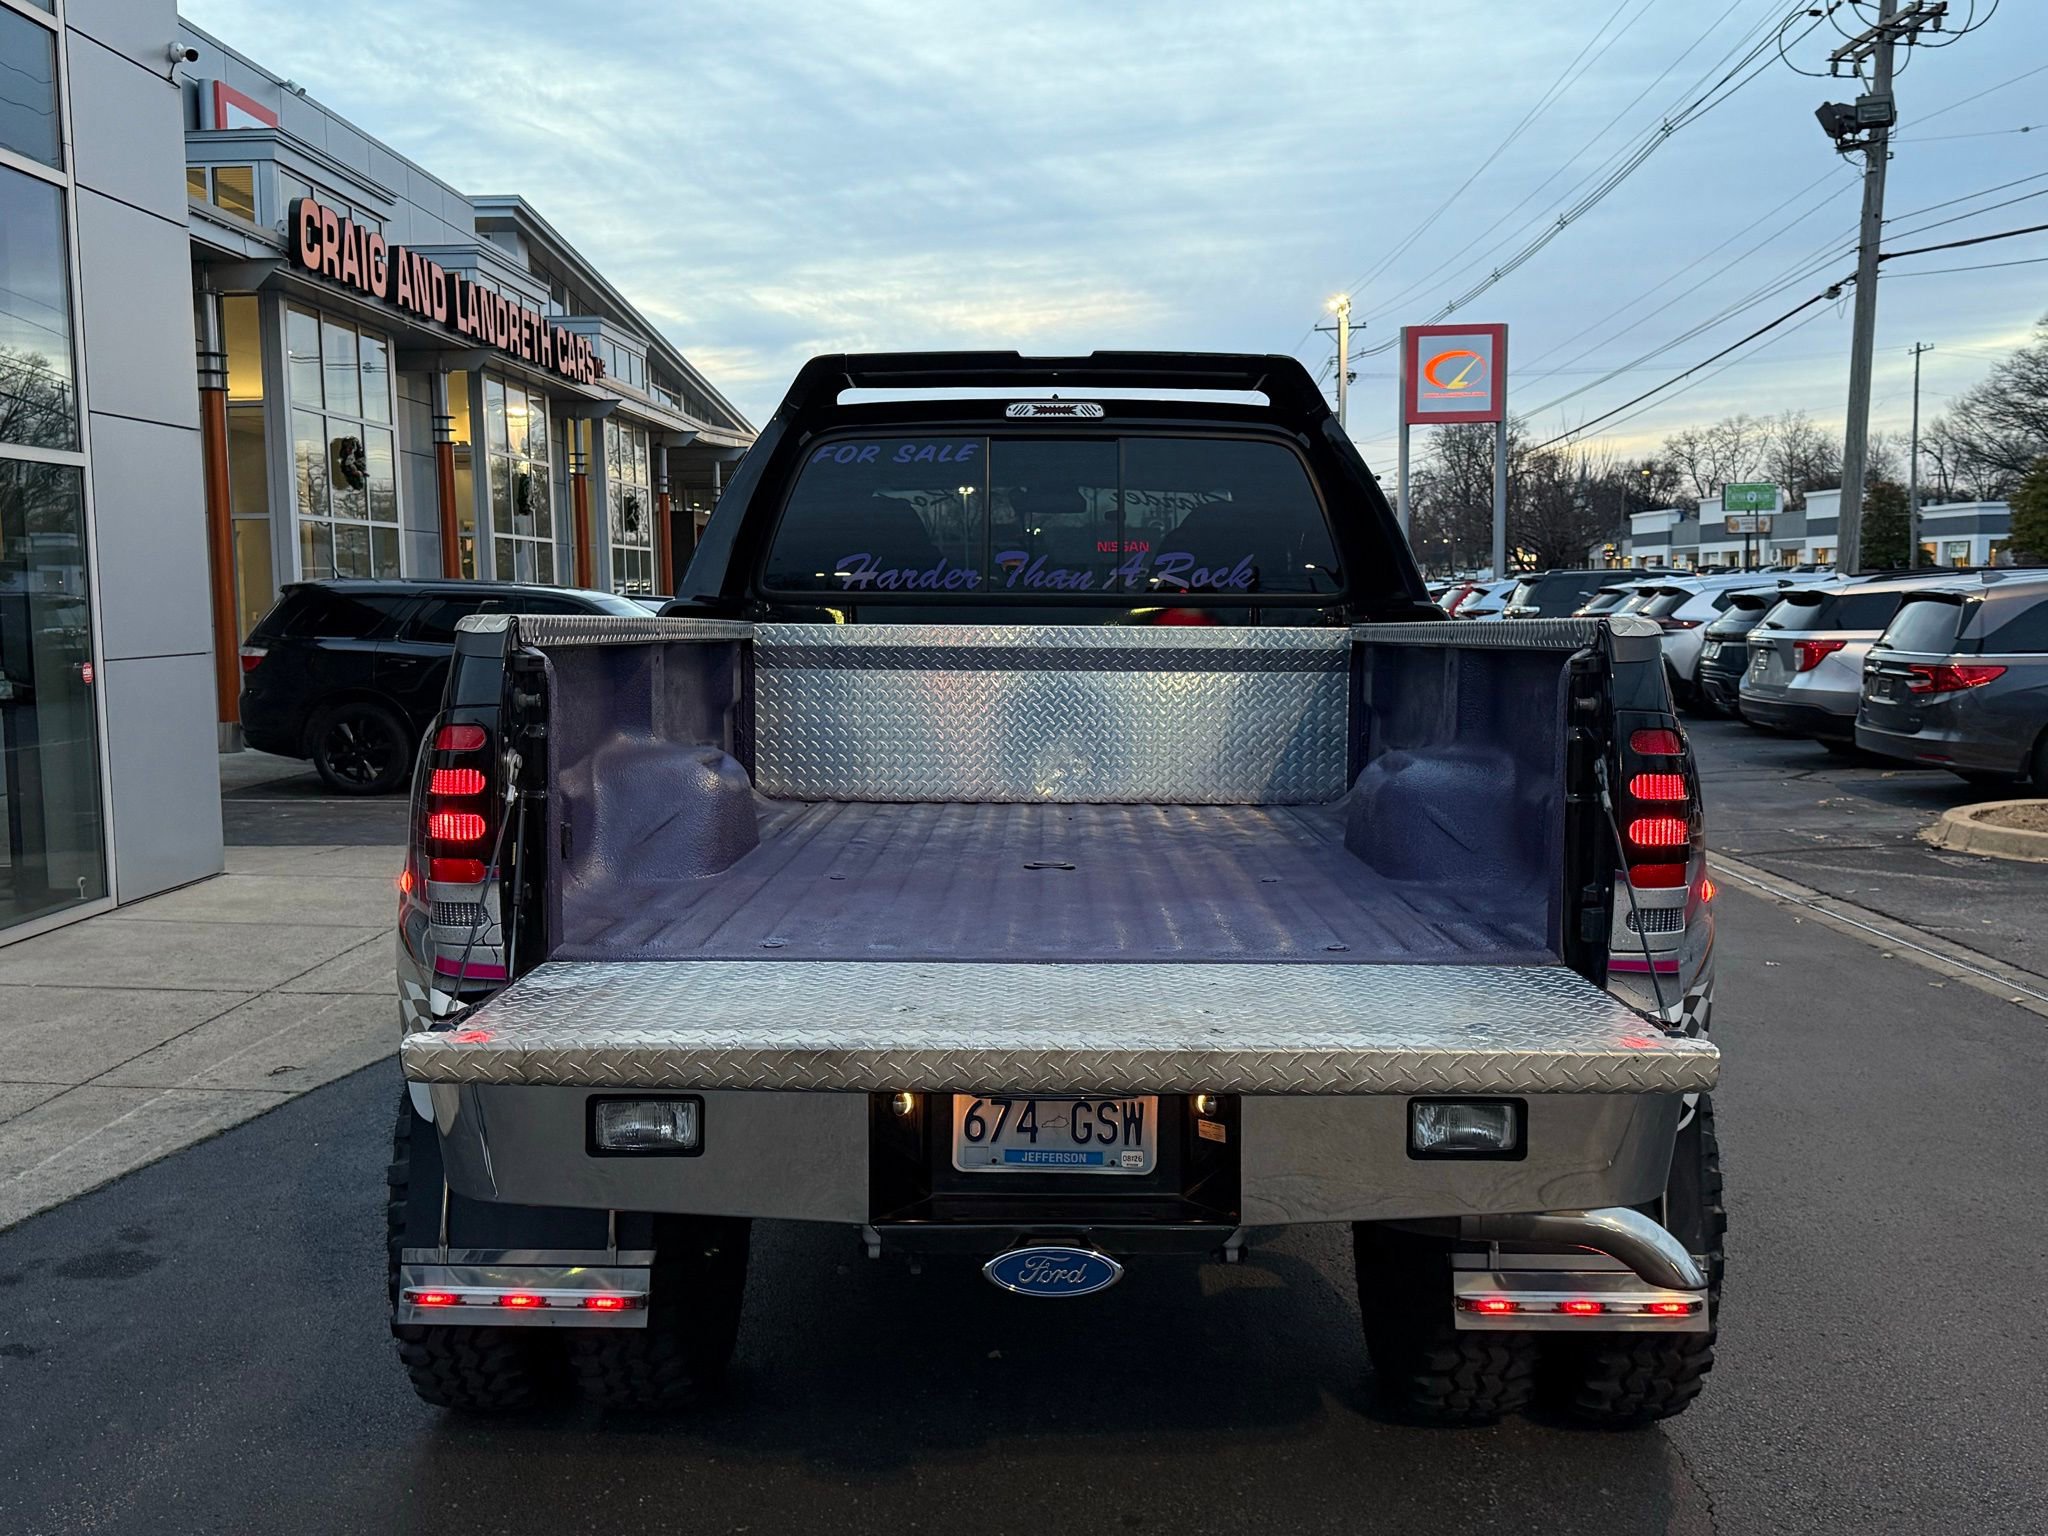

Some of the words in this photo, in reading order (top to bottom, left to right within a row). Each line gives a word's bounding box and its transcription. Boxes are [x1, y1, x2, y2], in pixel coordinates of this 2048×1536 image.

[300, 197, 388, 299] CRAIG
[397, 246, 448, 323] AND
[454, 272, 553, 369] LANDRETH
[557, 325, 595, 385] CARS
[812, 445, 881, 464] FOR
[892, 443, 980, 464] SALE
[836, 552, 982, 590] Harder
[995, 551, 1096, 591] Than
[1102, 552, 1141, 590] A
[1154, 552, 1256, 591] Rock
[963, 1099, 1039, 1144] 674
[1071, 1101, 1144, 1146] GSW
[1021, 1152, 1087, 1164] JEFFERSON
[1018, 1255, 1087, 1285] Ford
